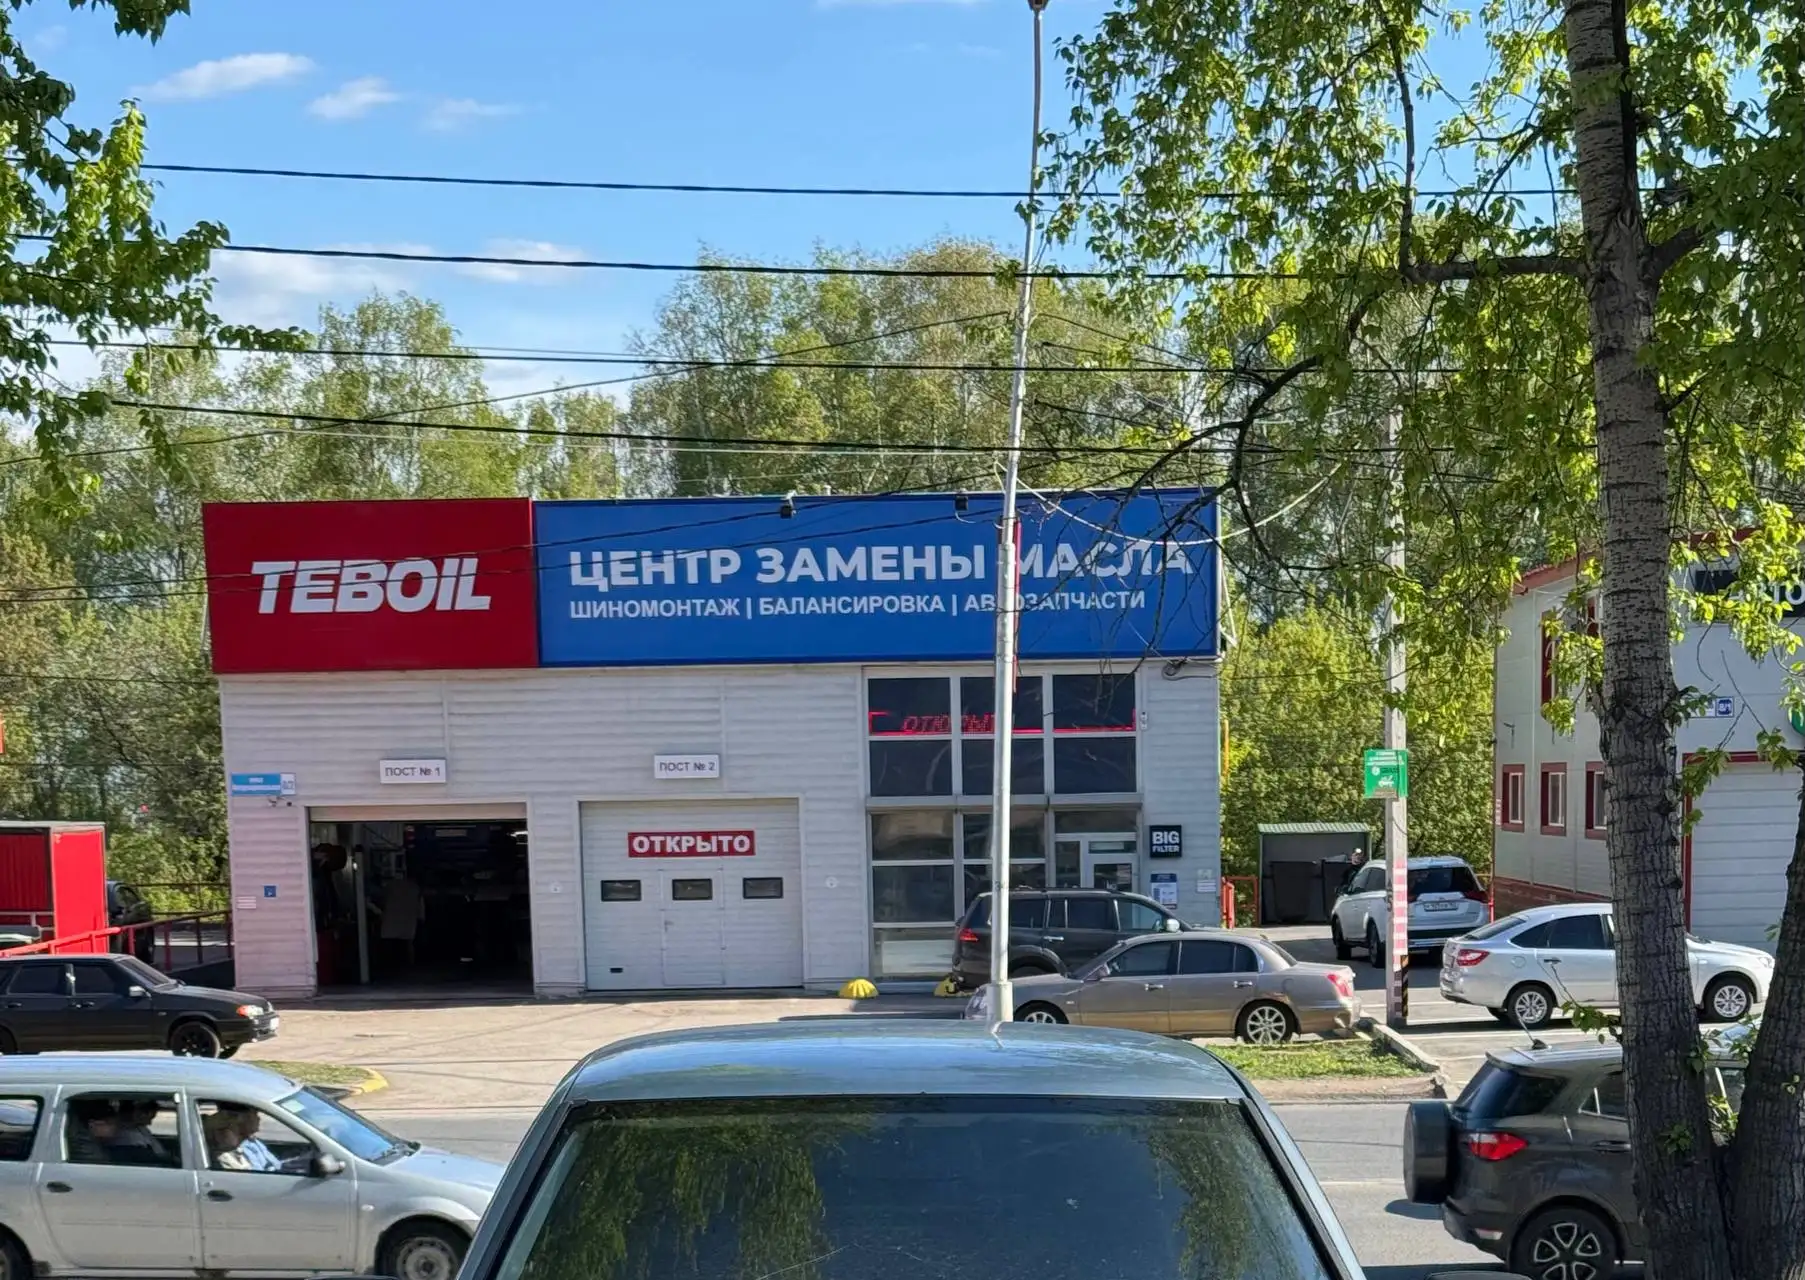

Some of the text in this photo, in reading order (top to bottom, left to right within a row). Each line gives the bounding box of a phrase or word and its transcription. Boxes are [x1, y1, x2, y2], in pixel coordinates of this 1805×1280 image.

[569, 549, 742, 593] ЦЕНТР
[755, 545, 986, 584] ЗАМЕНЫ
[251, 557, 492, 615] TEBOIL
[569, 599, 741, 619] ШИНОМОНТАЖ
[759, 595, 946, 615] БАЛАНСИРОВКА
[964, 591, 1145, 612] АВОЗАПЧАСТИ
[385, 767, 416, 777] ПОСТ
[434, 767, 441, 777] 1
[660, 762, 690, 772] ПОСТ
[708, 762, 716, 771] 2
[632, 835, 751, 853] ОТКРЫТО
[1152, 831, 1180, 844] BIG
